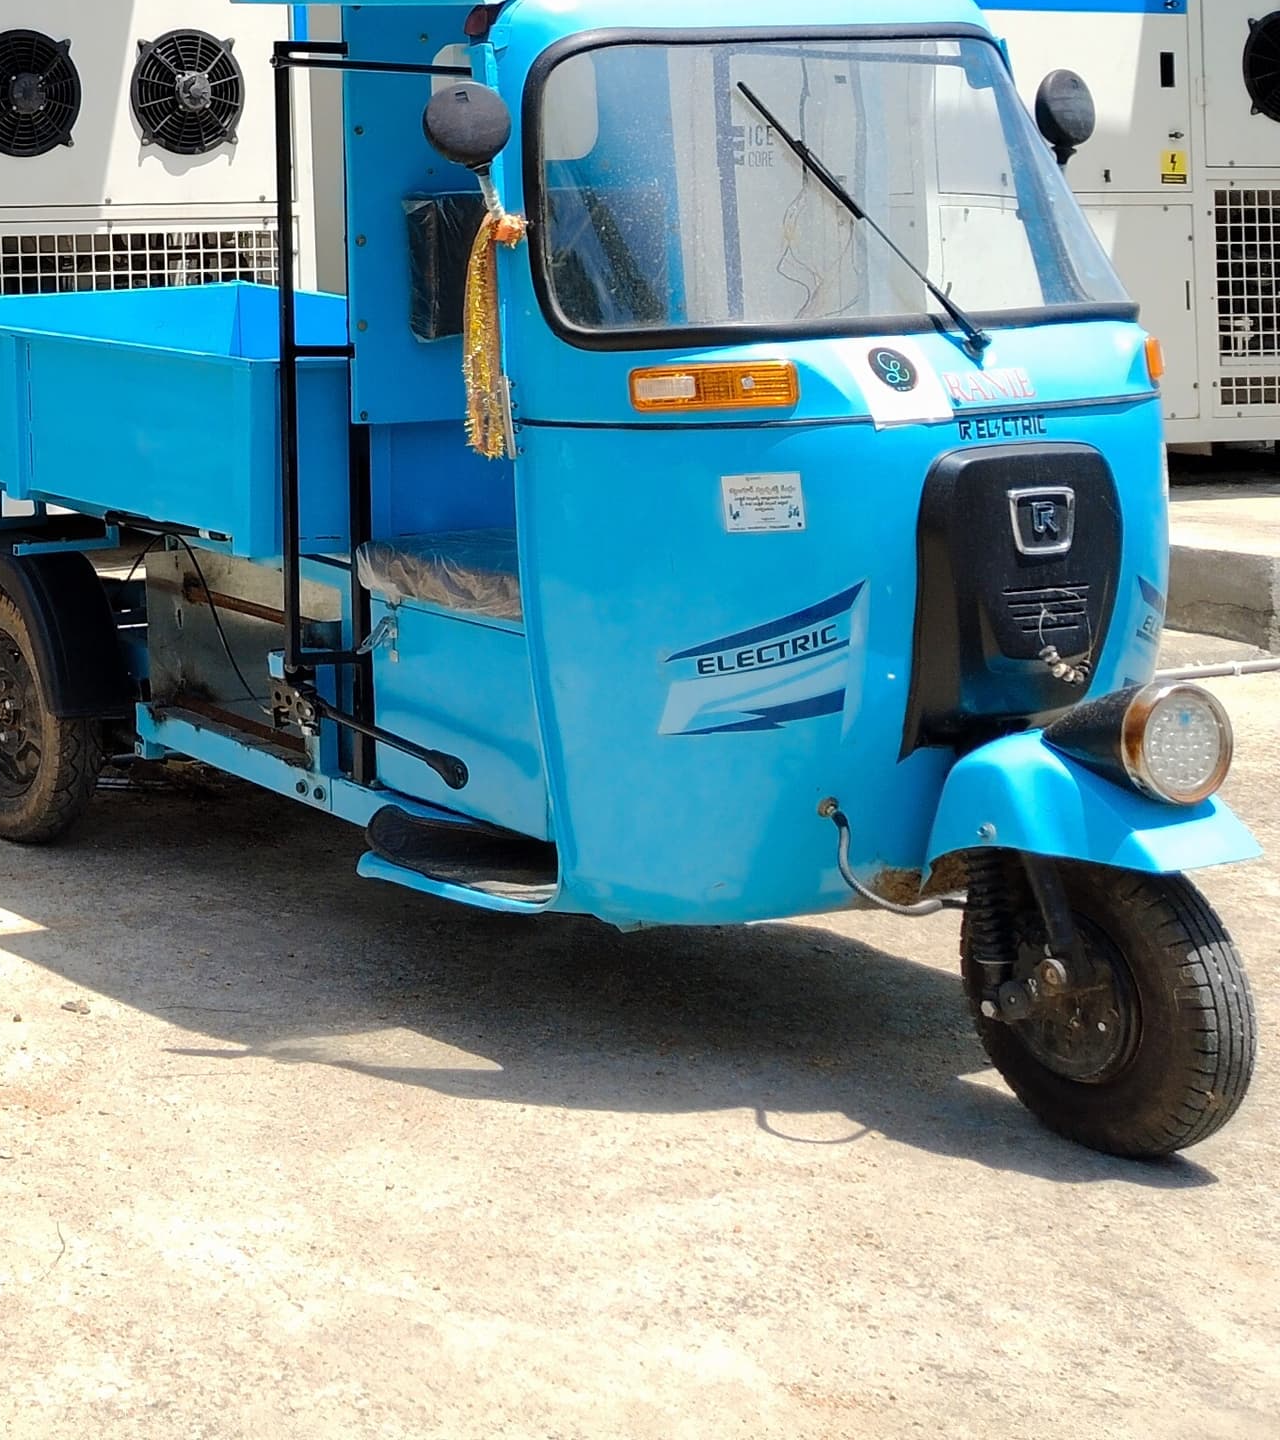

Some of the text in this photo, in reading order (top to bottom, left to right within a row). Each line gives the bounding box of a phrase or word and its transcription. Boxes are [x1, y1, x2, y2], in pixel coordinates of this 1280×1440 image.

[749, 125, 773, 146] ICE
[748, 150, 774, 167] CORE
[697, 623, 838, 675] ELECTRIC
